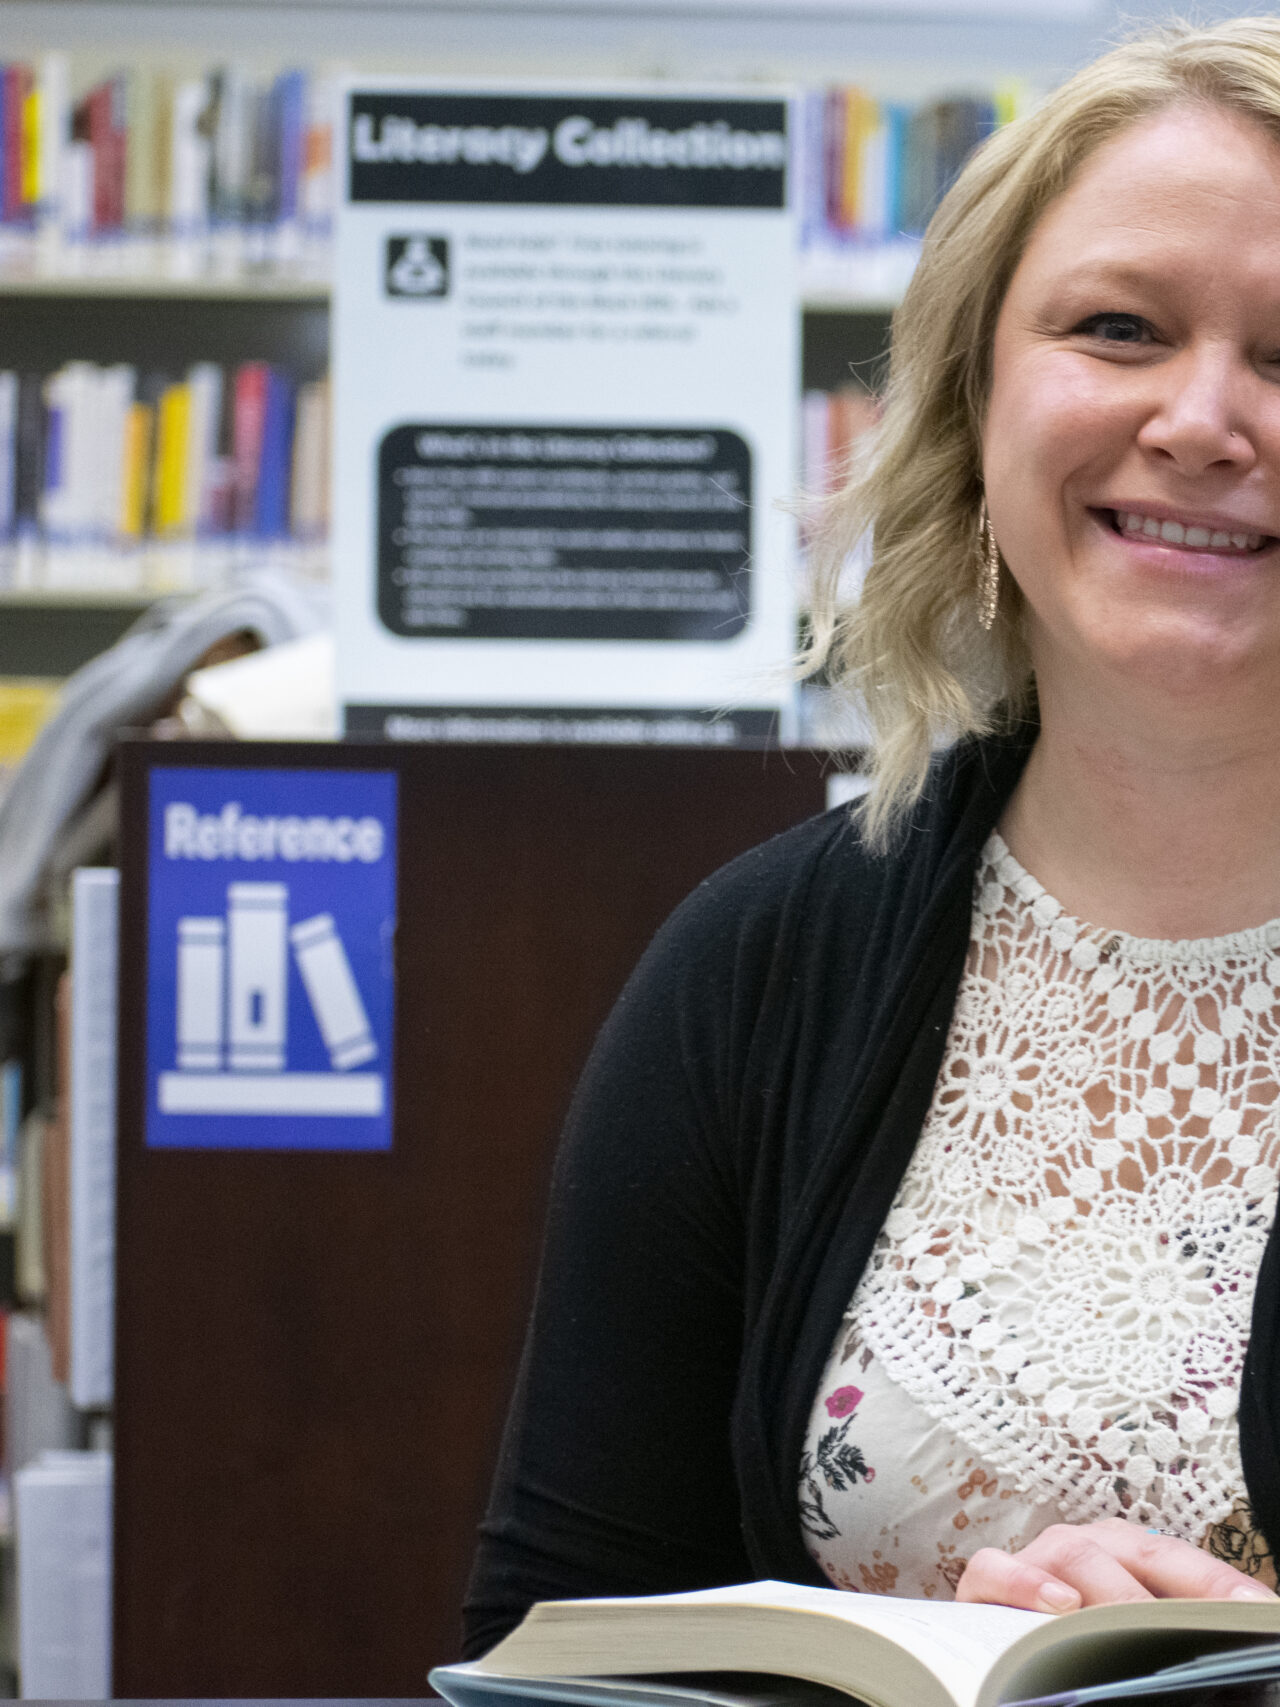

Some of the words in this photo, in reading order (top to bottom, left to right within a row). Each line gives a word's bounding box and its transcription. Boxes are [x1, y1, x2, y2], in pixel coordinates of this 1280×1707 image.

[354, 115, 548, 172] Literacy
[553, 116, 783, 168] Collection
[164, 802, 384, 862] Reference
